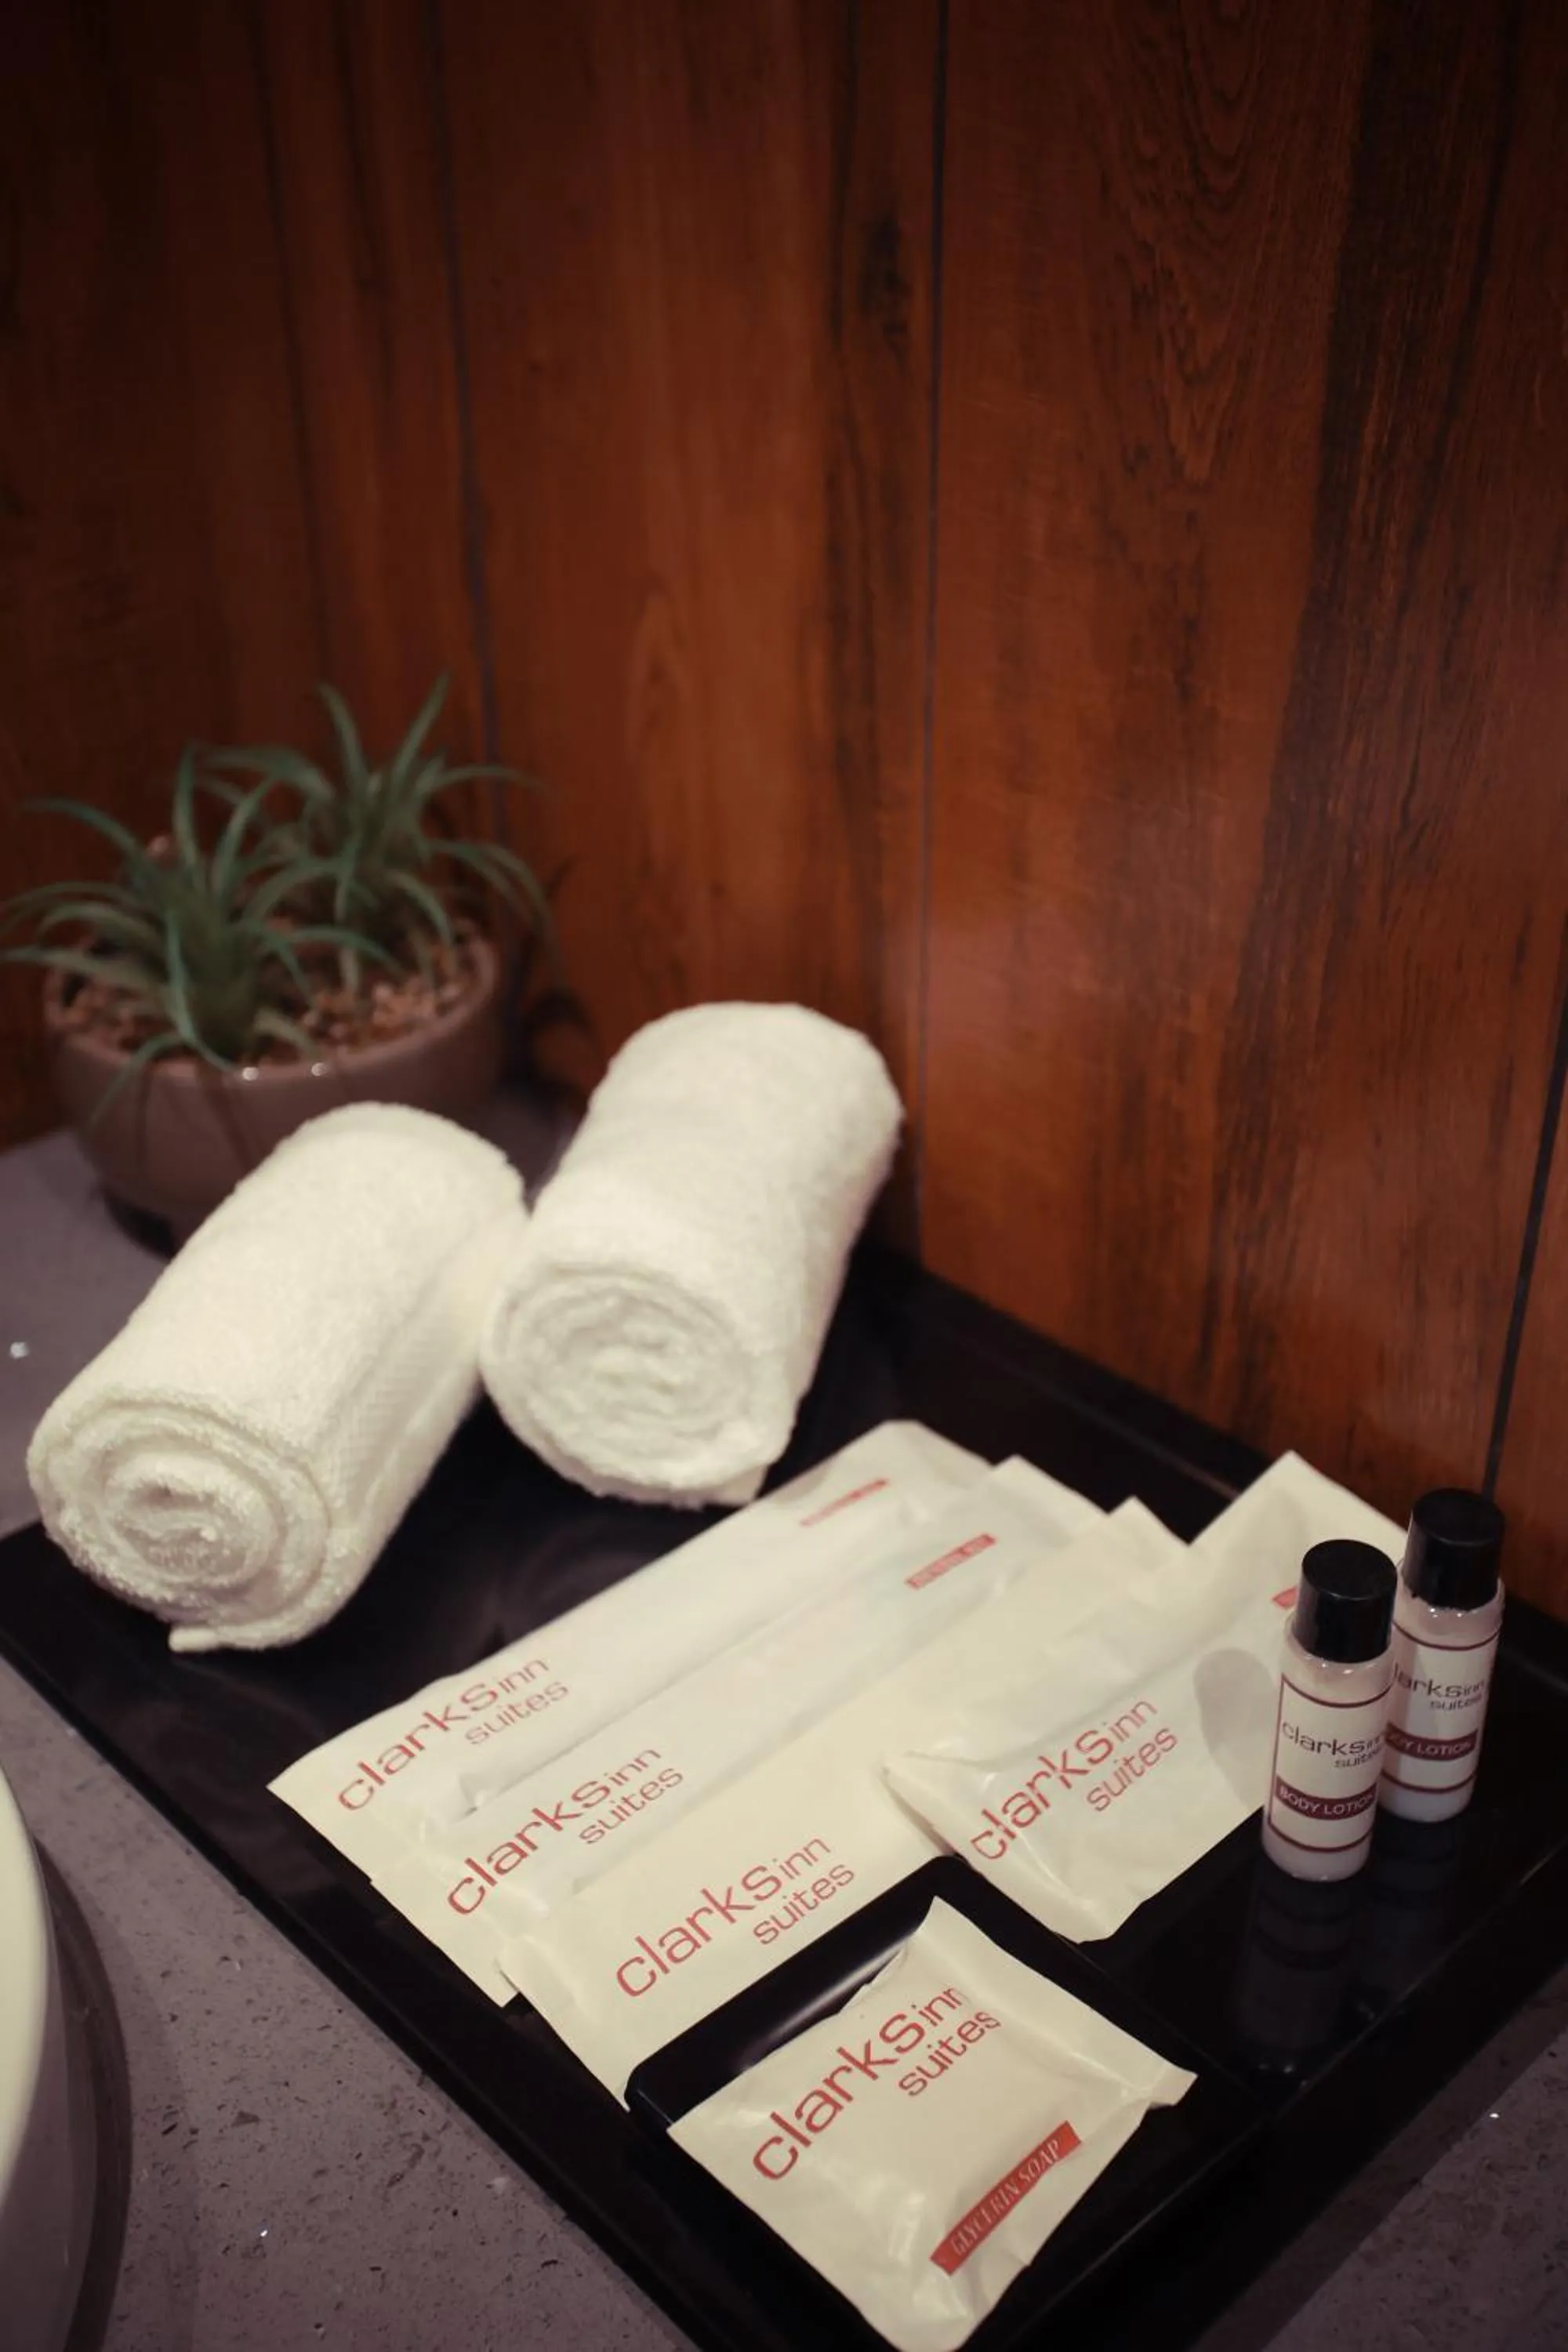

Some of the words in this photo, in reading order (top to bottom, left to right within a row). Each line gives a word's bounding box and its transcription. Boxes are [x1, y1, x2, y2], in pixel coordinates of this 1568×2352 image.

[465, 1680, 568, 1745] suites
[579, 1767, 684, 1845] suites
[1086, 1727, 1178, 1813] suites
[1279, 1786, 1320, 1815] BODY
[752, 1863, 855, 1945] suites
[898, 2011, 1002, 2097] suites
[949, 2177, 1021, 2256] GLYCERIN
[1018, 2139, 1059, 2183] SOAP
